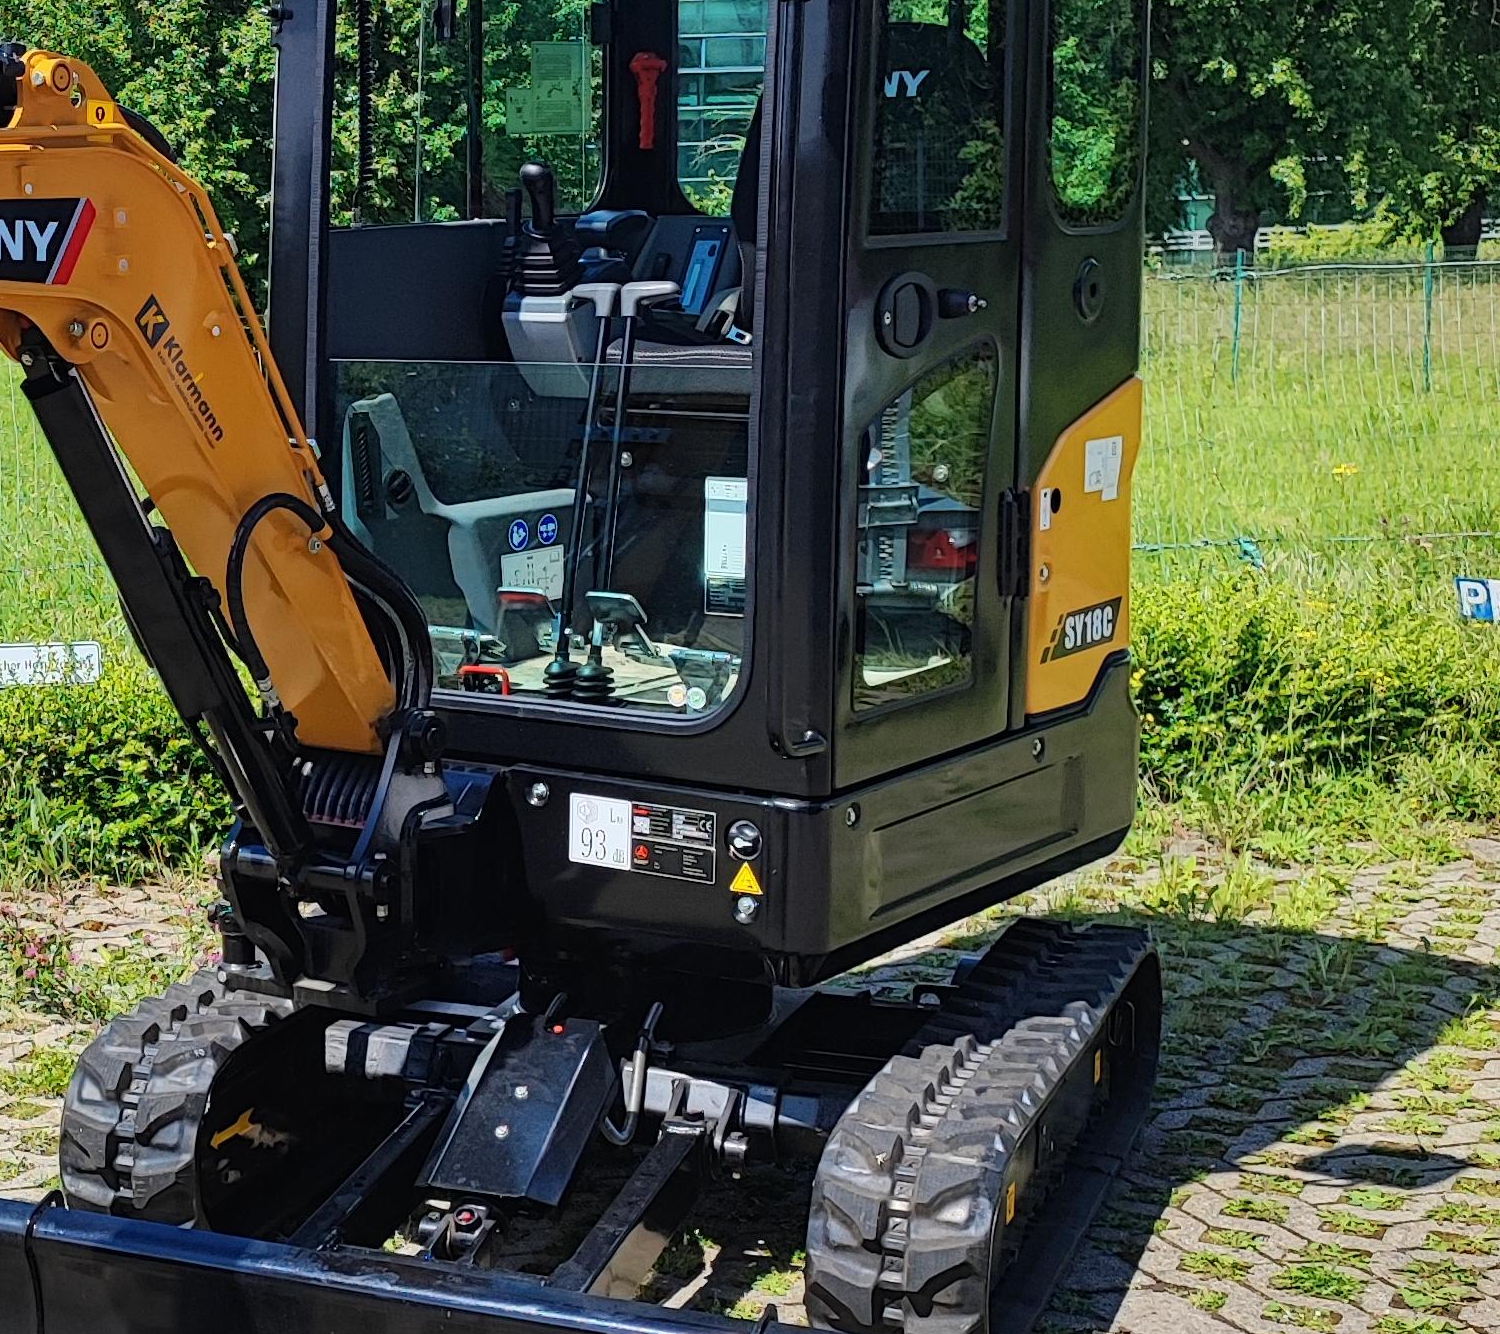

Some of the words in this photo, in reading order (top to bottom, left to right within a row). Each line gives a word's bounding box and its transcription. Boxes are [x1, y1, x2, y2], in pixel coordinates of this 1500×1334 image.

[163, 335, 224, 442] Klarmann
[1458, 579, 1488, 616] P
[1064, 605, 1113, 650] SY18C
[581, 827, 607, 861] 93
